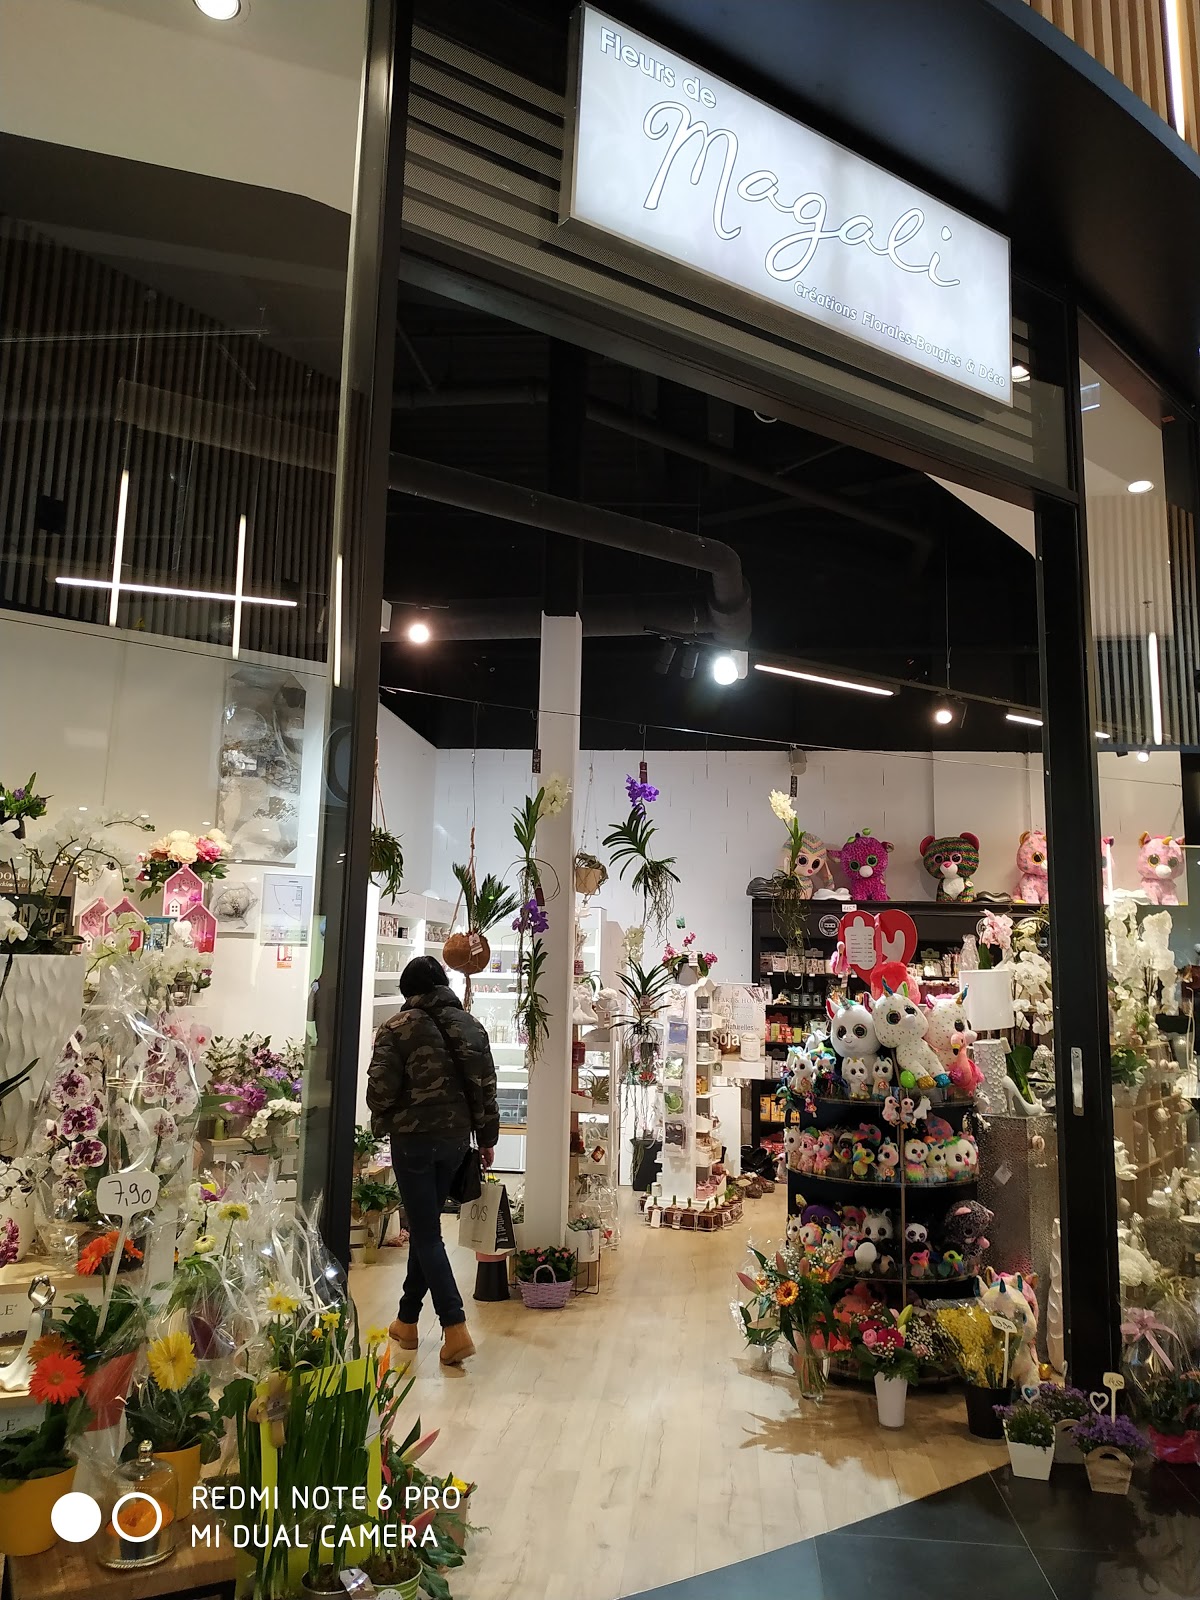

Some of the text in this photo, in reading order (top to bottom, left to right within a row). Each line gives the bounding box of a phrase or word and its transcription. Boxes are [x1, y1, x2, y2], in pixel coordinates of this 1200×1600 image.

[600, 26, 717, 109] Fleurs de
[642, 100, 961, 288] Magali
[793, 280, 1006, 388] Créations Florales-Bougies & Déco
[107, 1180, 152, 1207] 7,90
